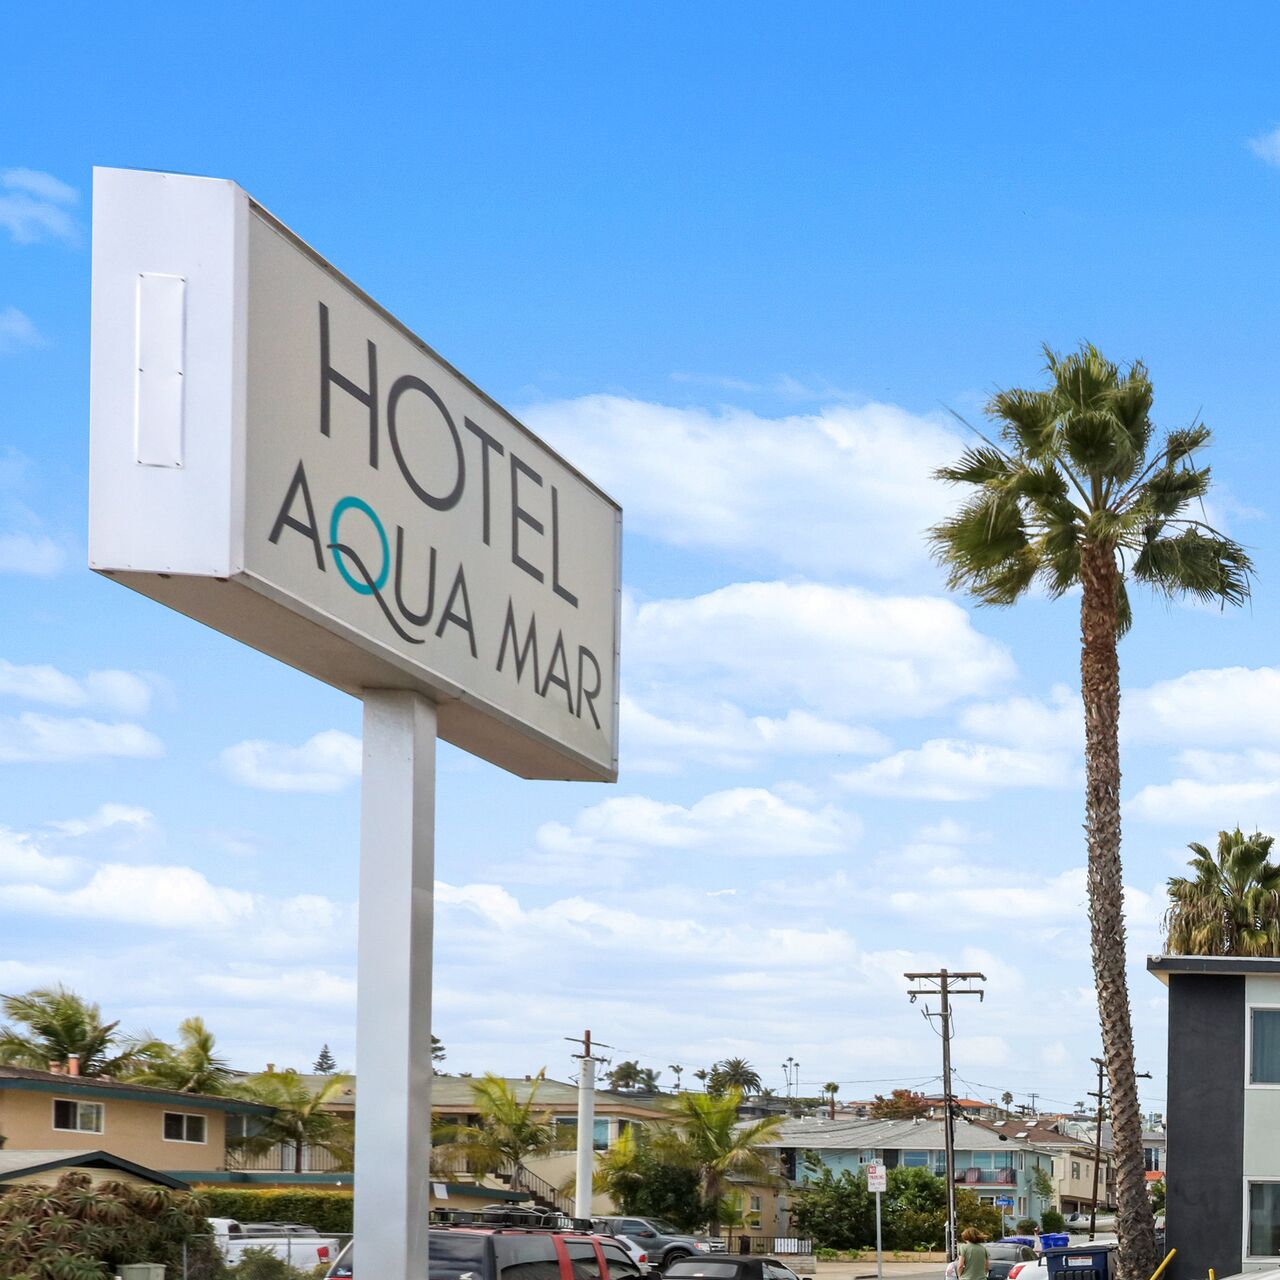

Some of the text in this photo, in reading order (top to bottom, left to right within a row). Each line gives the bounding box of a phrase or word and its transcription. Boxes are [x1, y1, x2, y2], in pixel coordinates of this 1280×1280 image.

[268, 459, 601, 730] AQUA MAR
[318, 301, 579, 608] HOTEL
